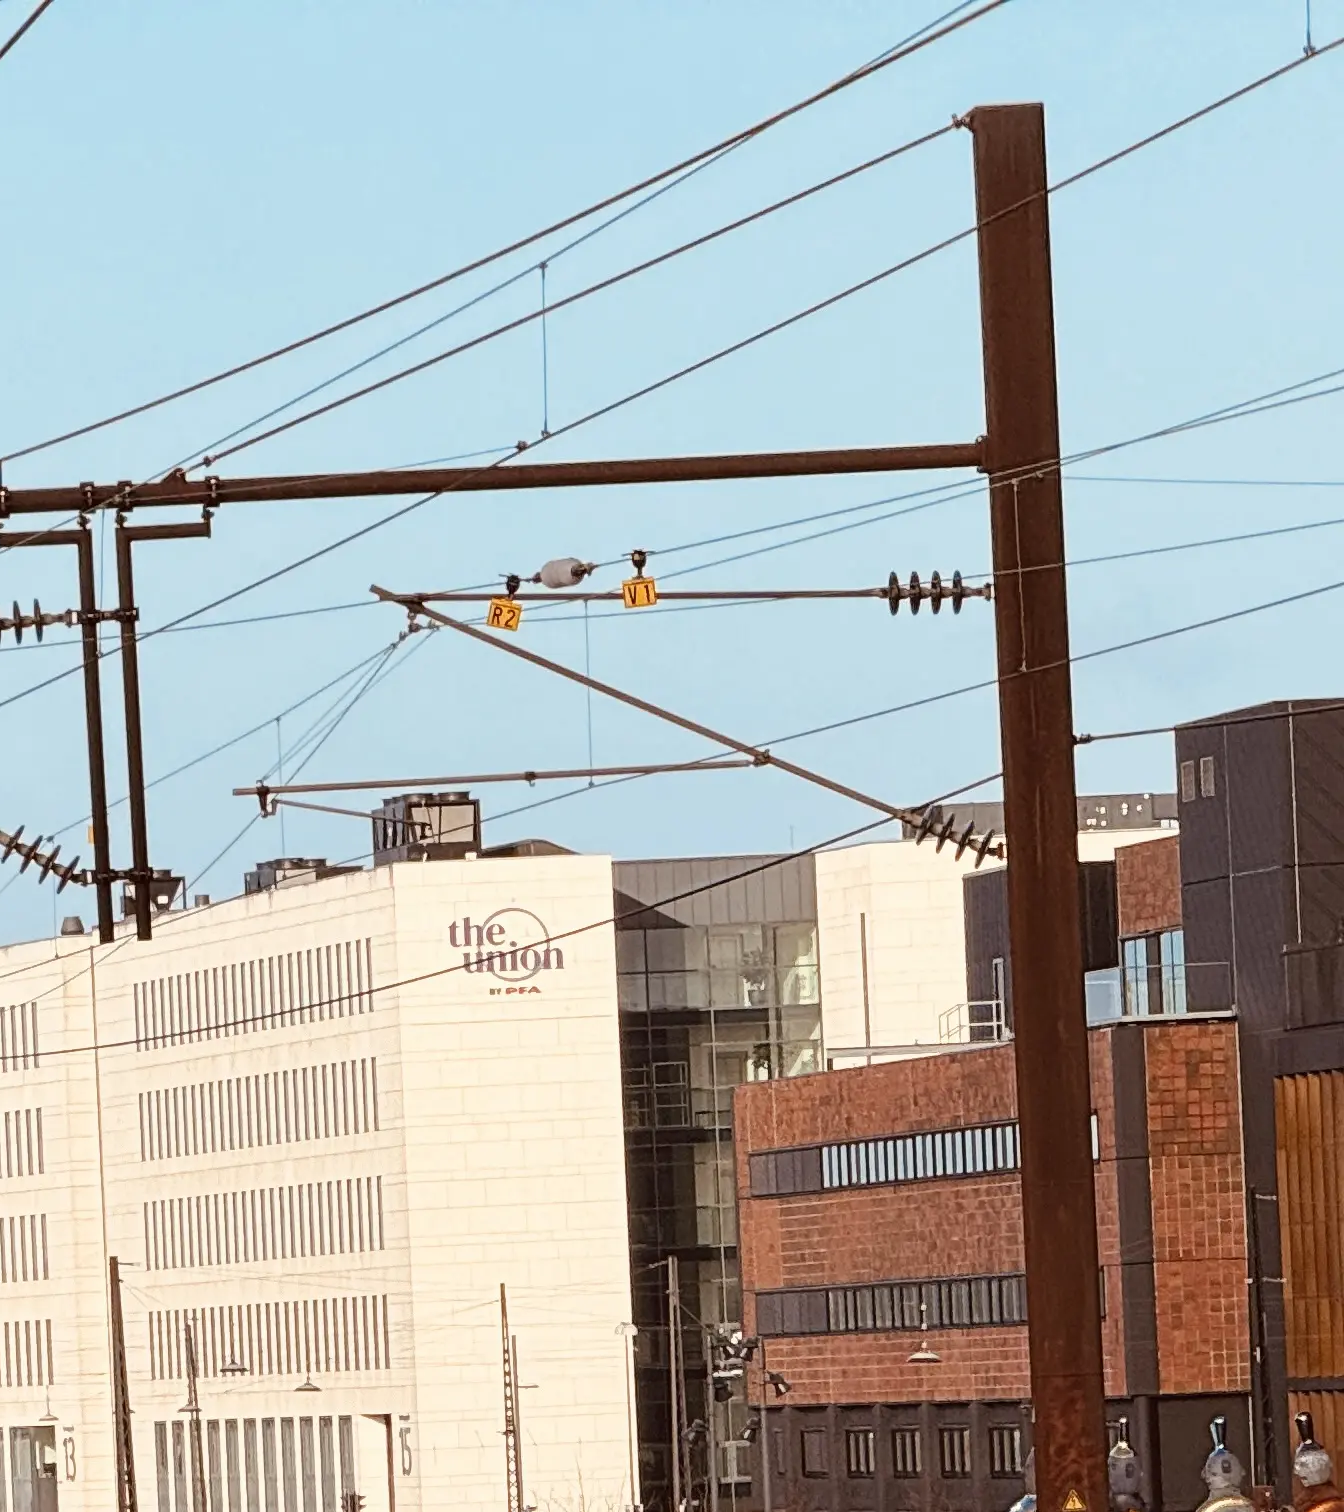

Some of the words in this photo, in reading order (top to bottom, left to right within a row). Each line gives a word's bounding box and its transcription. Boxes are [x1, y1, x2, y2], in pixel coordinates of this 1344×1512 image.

[628, 584, 653, 606] V1
[490, 605, 516, 629] R2
[448, 916, 506, 948] the
[462, 940, 565, 974] union
[505, 985, 542, 995] PFA
